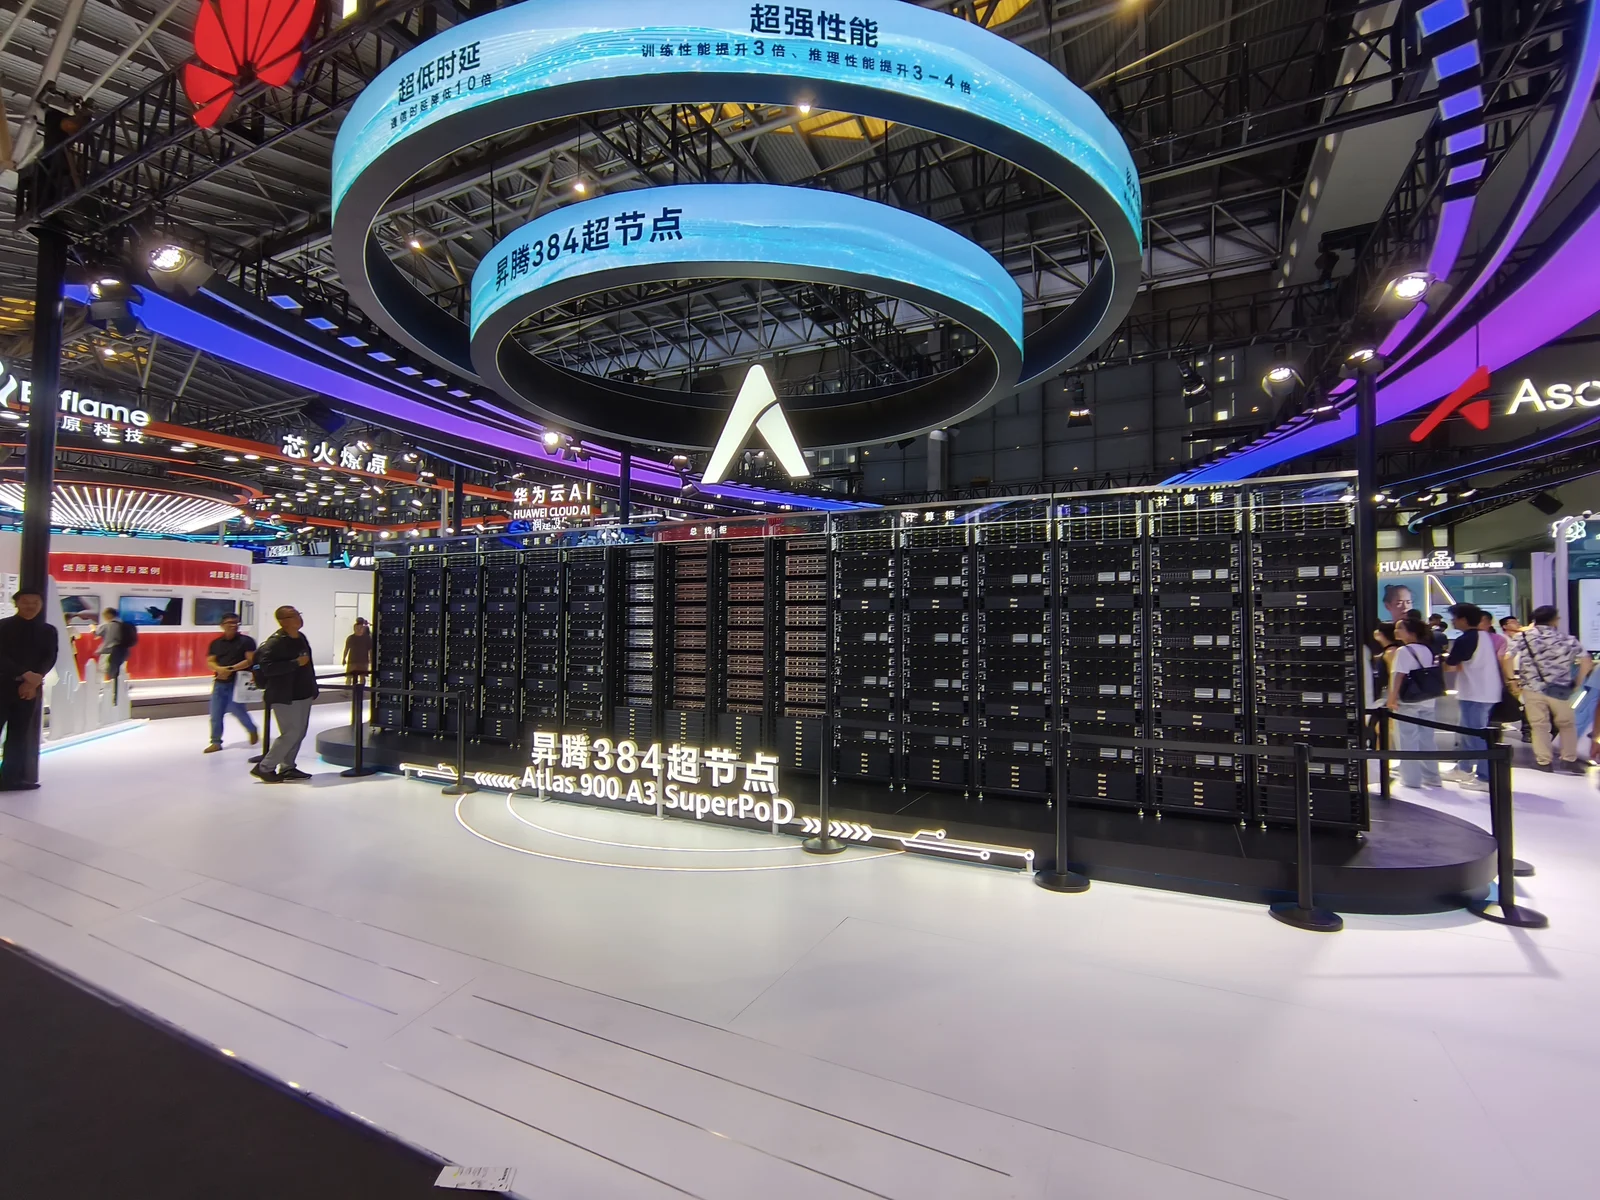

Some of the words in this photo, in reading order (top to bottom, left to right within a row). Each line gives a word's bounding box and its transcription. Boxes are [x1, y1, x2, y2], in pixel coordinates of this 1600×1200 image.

[750, 3, 879, 48] 超强性能
[398, 41, 480, 106] 超低时延
[496, 207, 683, 291] 昇腾384超节点
[20, 380, 150, 427] Eflame
[61, 416, 144, 444] 原科技
[513, 507, 548, 519] HUAWEI
[549, 506, 577, 517] CLOUD
[580, 505, 591, 515] AI
[514, 482, 592, 506] 华为云AI
[1154, 492, 1224, 507] 计算柜
[904, 510, 955, 522] 计算柜
[1379, 558, 1430, 572] HUAWE
[532, 731, 780, 794] 昇腾384超节点
[521, 766, 576, 794] Atlas
[580, 773, 623, 801] 900
[625, 778, 658, 806] A3
[665, 784, 796, 825] SuperPoD
